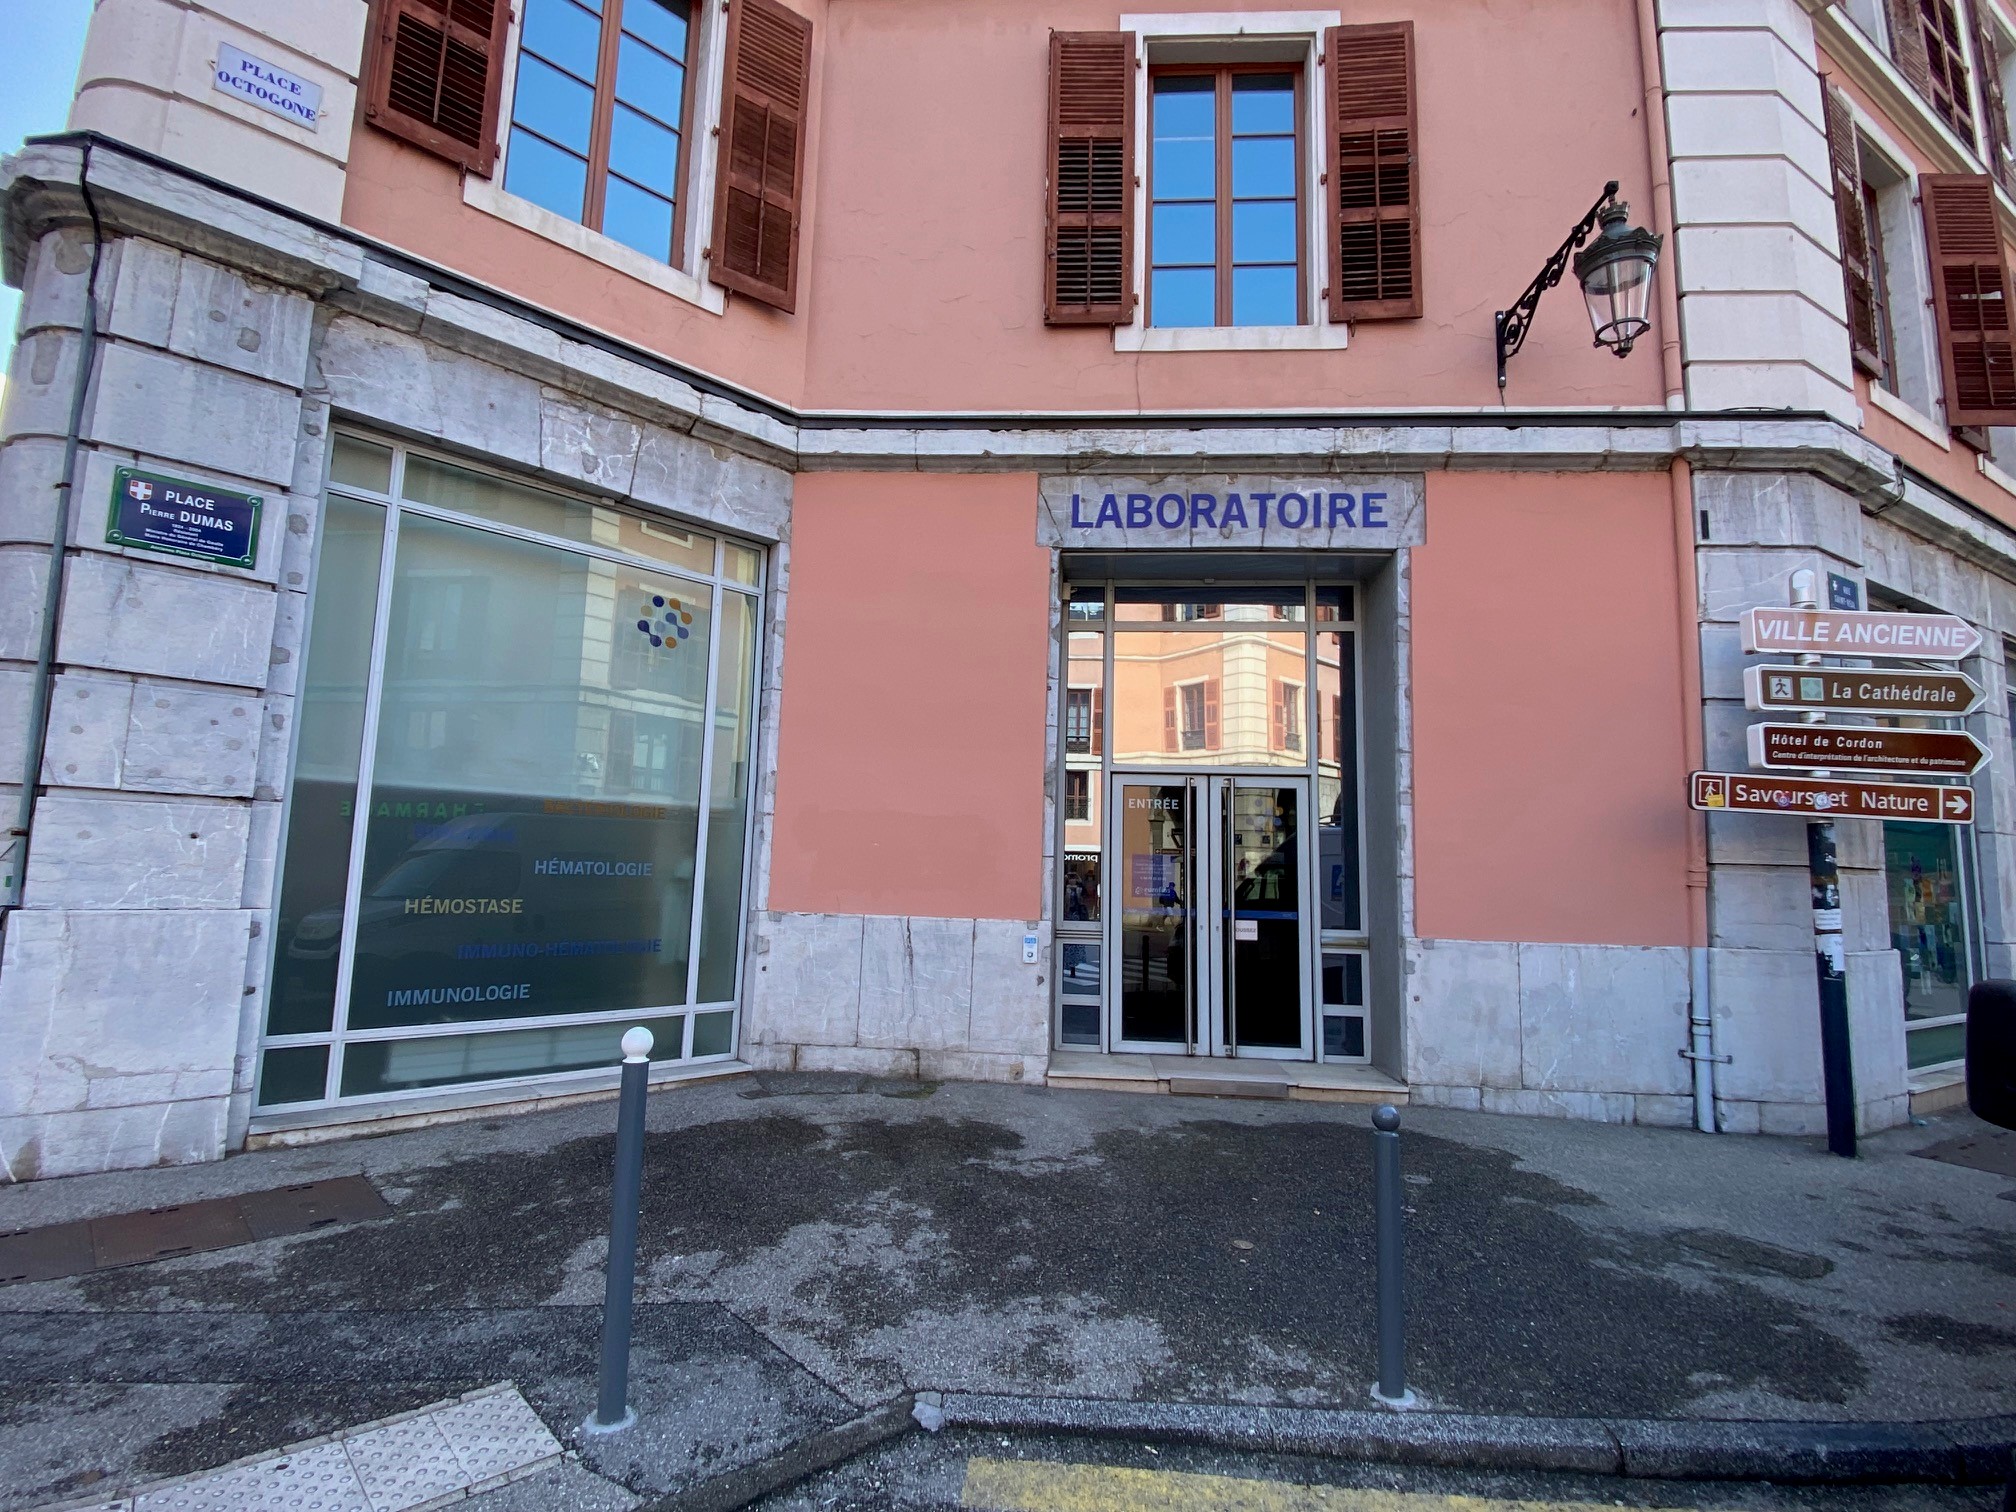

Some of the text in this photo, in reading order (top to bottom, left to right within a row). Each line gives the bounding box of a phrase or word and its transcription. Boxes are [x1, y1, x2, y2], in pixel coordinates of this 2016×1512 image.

[240, 60, 301, 95] PLACE
[218, 71, 316, 121] OCTOGONE
[166, 490, 215, 511] PLACE
[1071, 492, 1388, 529] LABORATOIRE
[180, 511, 234, 532] DUMAS
[1758, 619, 1968, 647] VILLE ANCIENNE
[1832, 682, 1956, 703] La Cathédrale
[1771, 733, 1883, 749] Hôtel de Cordon
[1772, 751, 1797, 759] Centre
[1853, 754, 1862, 762] de
[1919, 757, 1928, 765] du
[1929, 757, 1966, 767] patrimoine
[1128, 797, 1179, 810] ENTRÉE
[1828, 791, 1848, 807] et
[1861, 791, 1929, 812] Nature
[534, 858, 653, 876] HÉMATOLOGIE
[404, 895, 523, 914] HÉMOSTASE
[387, 983, 531, 1007] IMMUNOLOGIE
